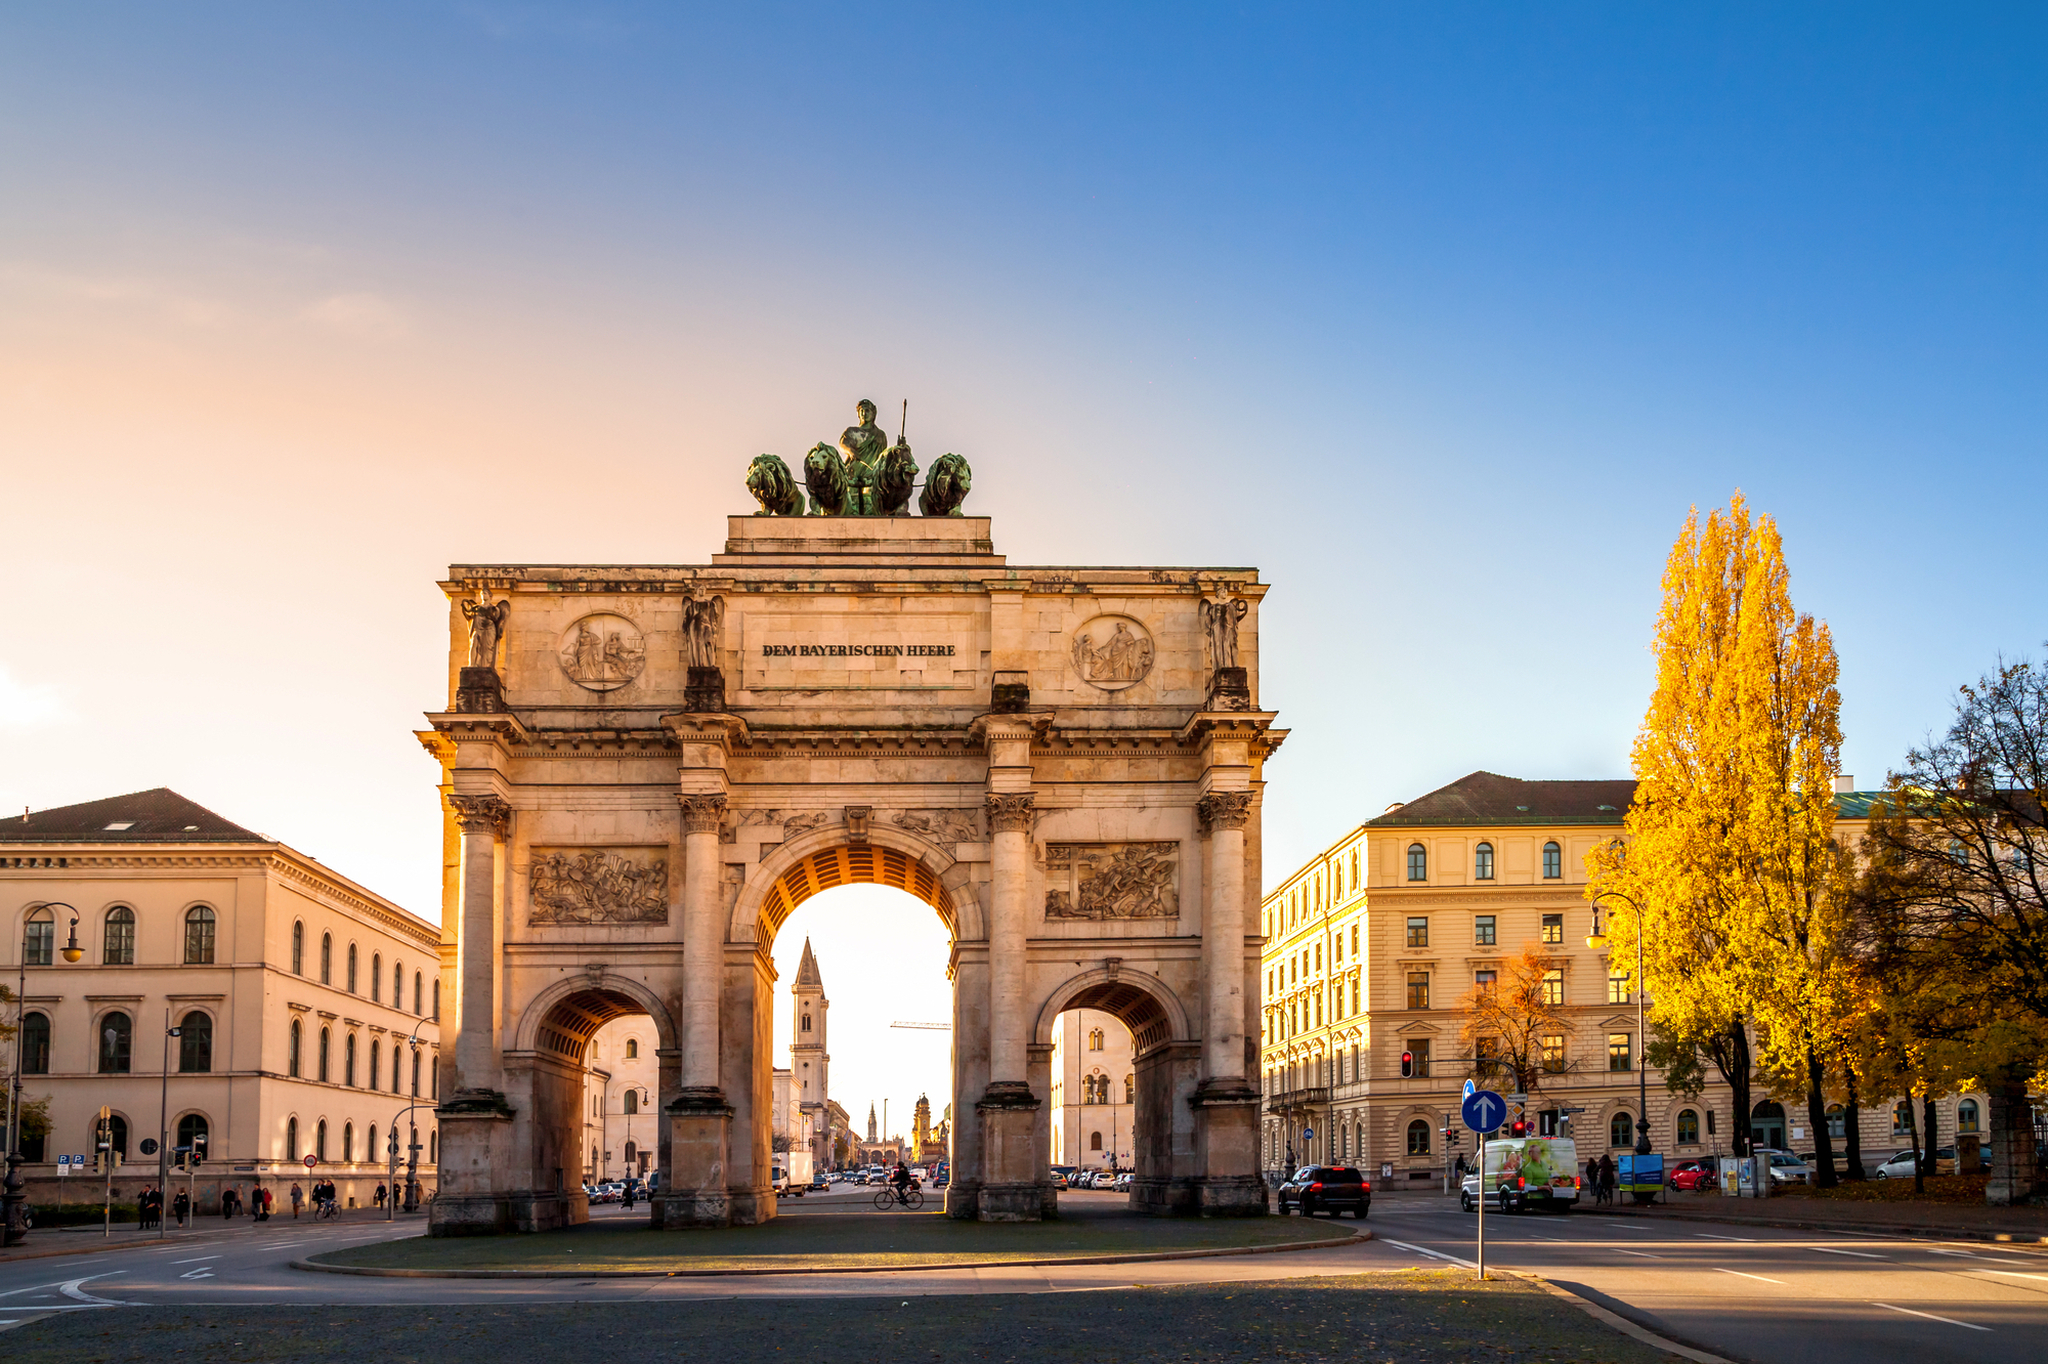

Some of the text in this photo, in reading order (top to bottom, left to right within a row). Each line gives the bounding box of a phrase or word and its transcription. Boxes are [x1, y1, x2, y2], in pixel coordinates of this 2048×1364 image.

[762, 645, 955, 656] DEM BAYERISCHEN HEERE
